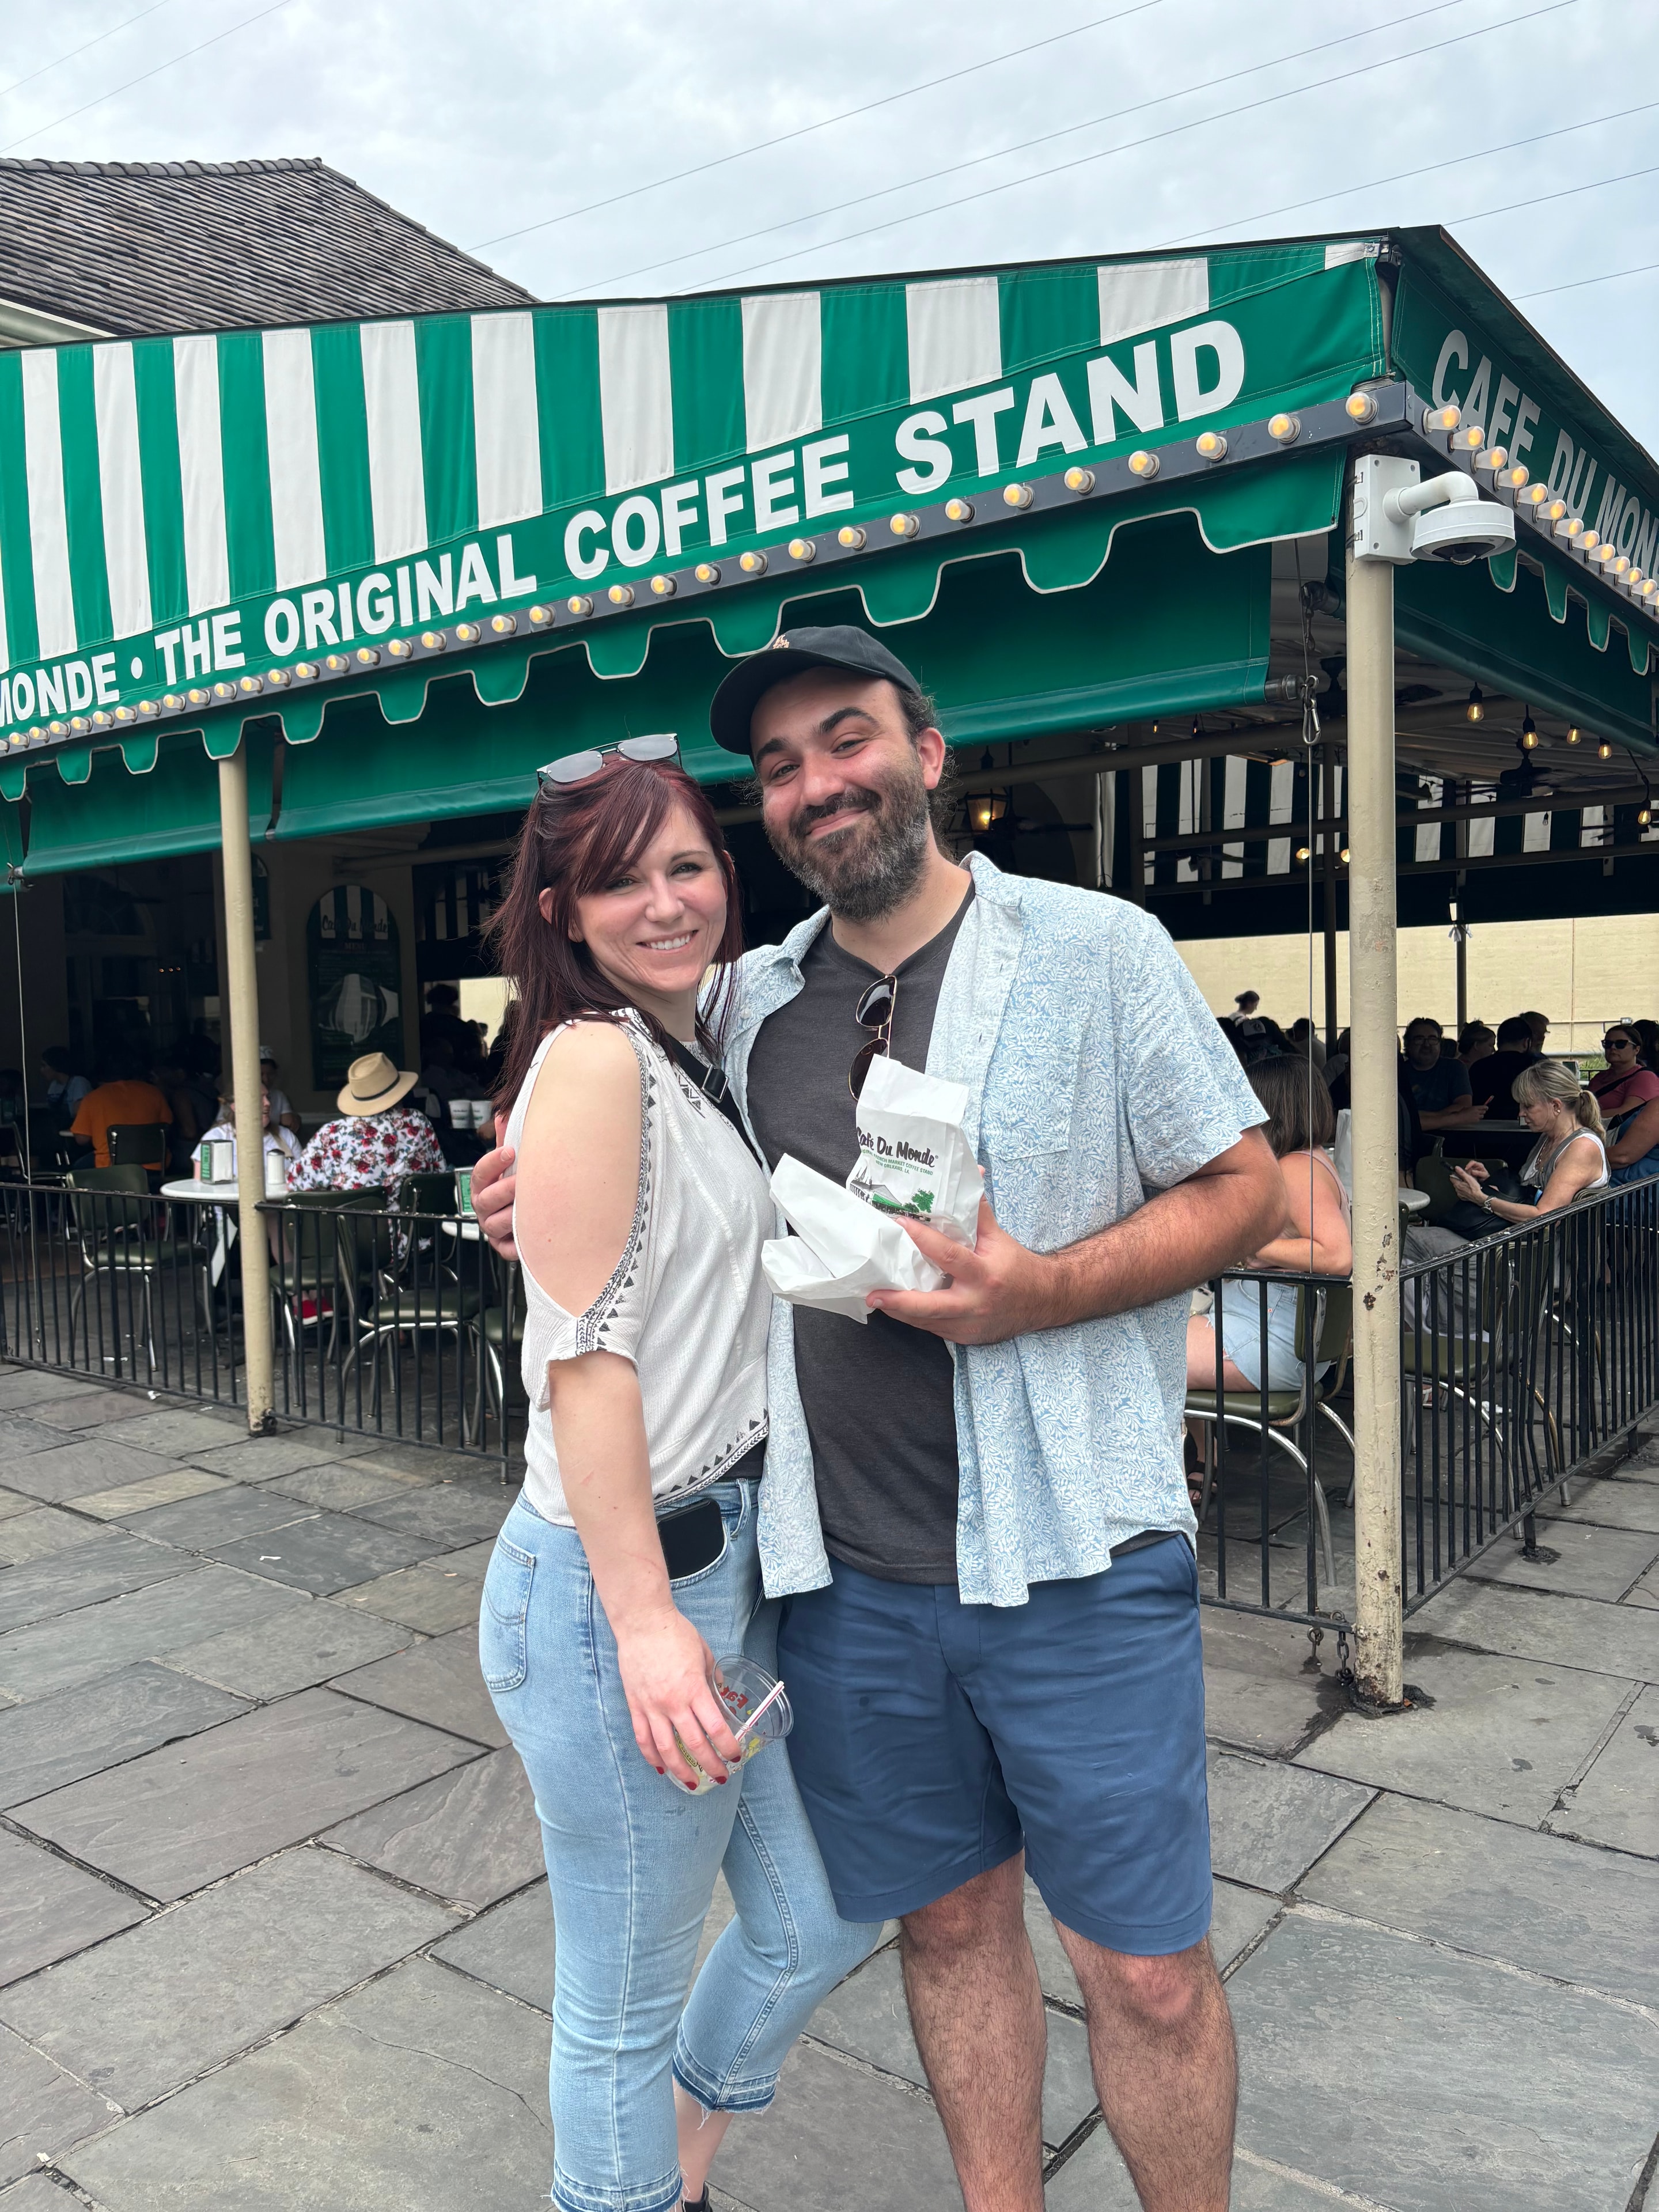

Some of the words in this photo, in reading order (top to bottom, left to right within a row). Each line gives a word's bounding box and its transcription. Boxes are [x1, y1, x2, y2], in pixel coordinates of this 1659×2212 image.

[154, 611, 245, 685] THE
[264, 534, 536, 656] ORIGINAL
[564, 434, 854, 579] COFFEE
[895, 320, 1245, 494] STAND
[1433, 329, 1540, 470] CAFE
[1548, 429, 1598, 518] DU
[1595, 474, 1659, 579] MON
[873, 1153, 887, 1162] FRENCH
[888, 1158, 905, 1167] MARKET
[906, 1163, 919, 1172] COFFEE
[920, 1168, 933, 1176] STAND
[877, 1137, 893, 1156] Du
[896, 1141, 935, 1168] Monde
